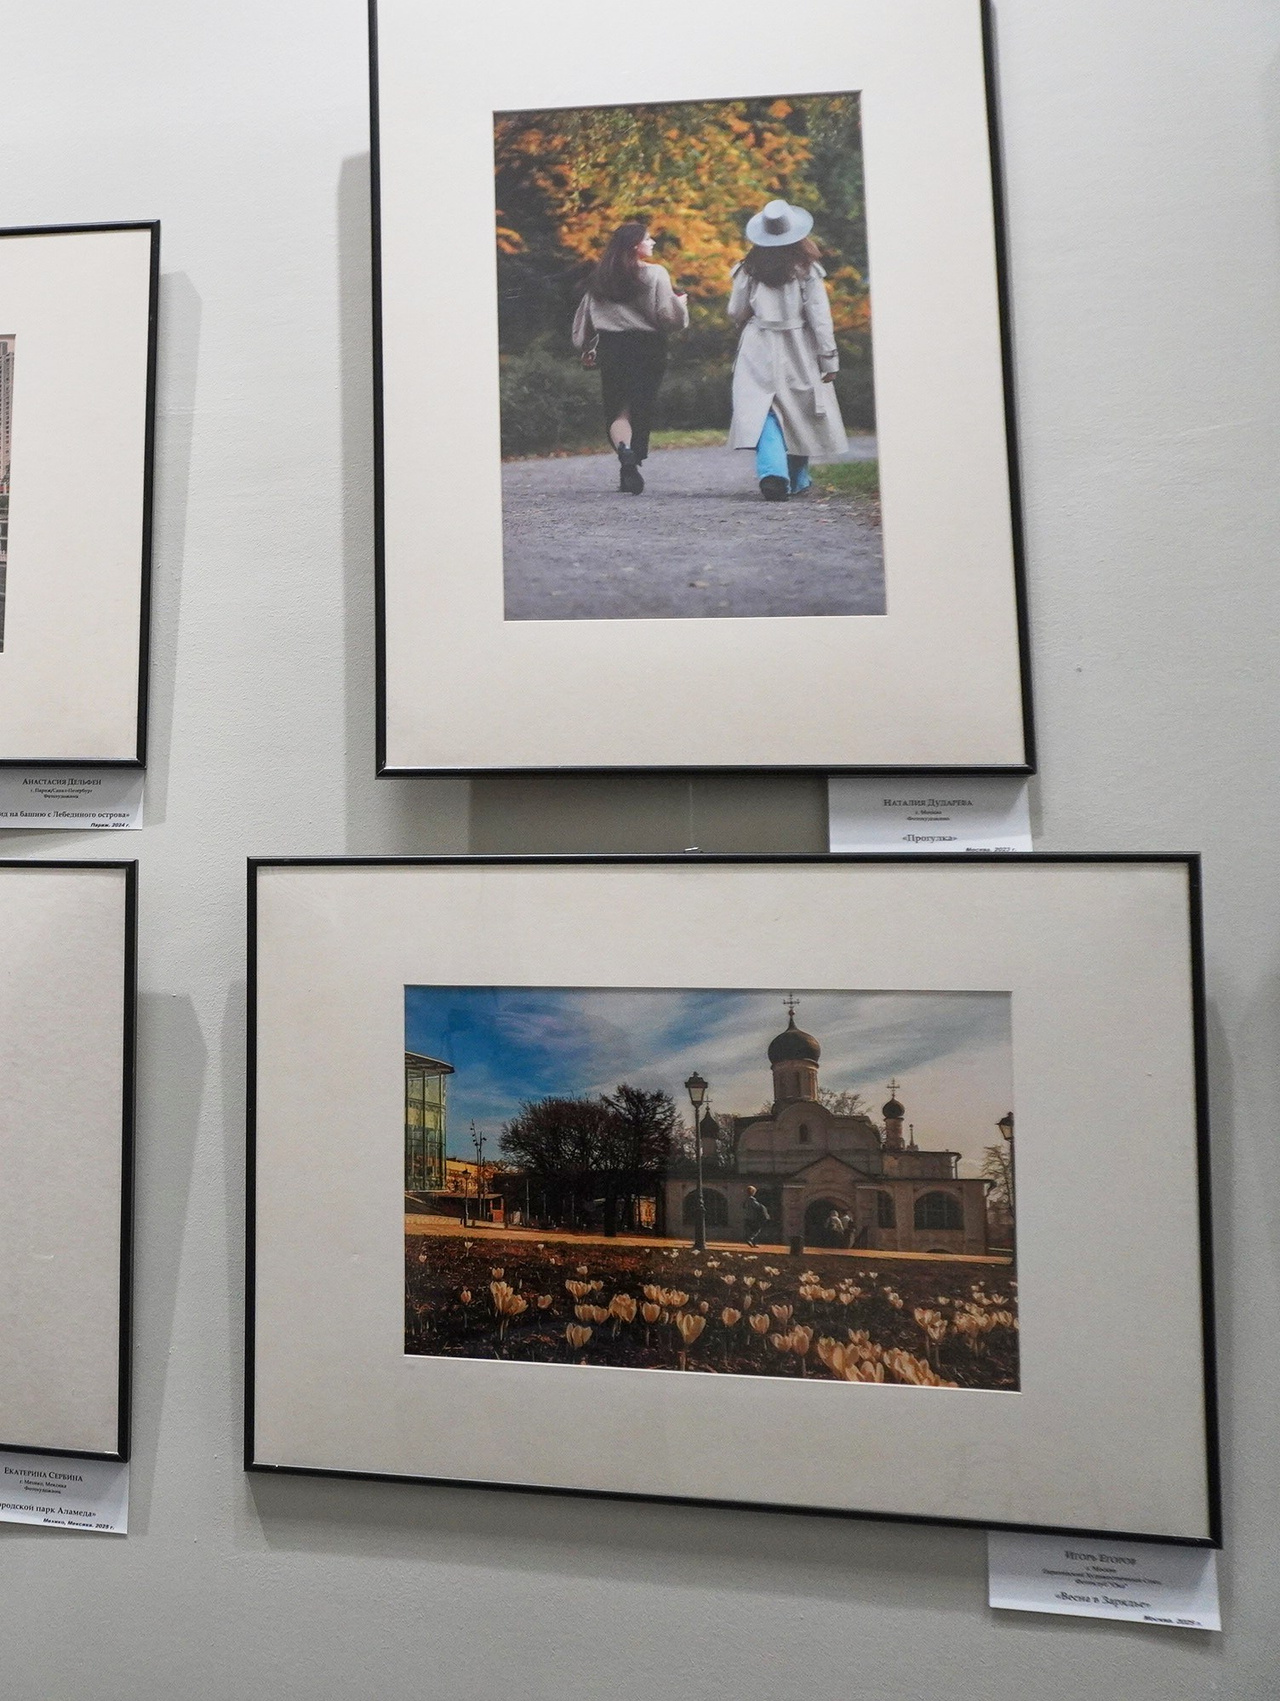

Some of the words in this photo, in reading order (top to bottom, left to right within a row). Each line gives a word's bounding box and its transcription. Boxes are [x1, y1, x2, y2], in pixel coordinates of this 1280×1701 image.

[53, 811, 96, 819] Лебединого
[902, 834, 958, 843] «Прогулка»
[4, 1467, 47, 1478] ЕКАТЕРИНА
[48, 1471, 83, 1482] СЕРБИНА
[36, 1506, 55, 1514] парк
[57, 1507, 96, 1518] Аламеда»
